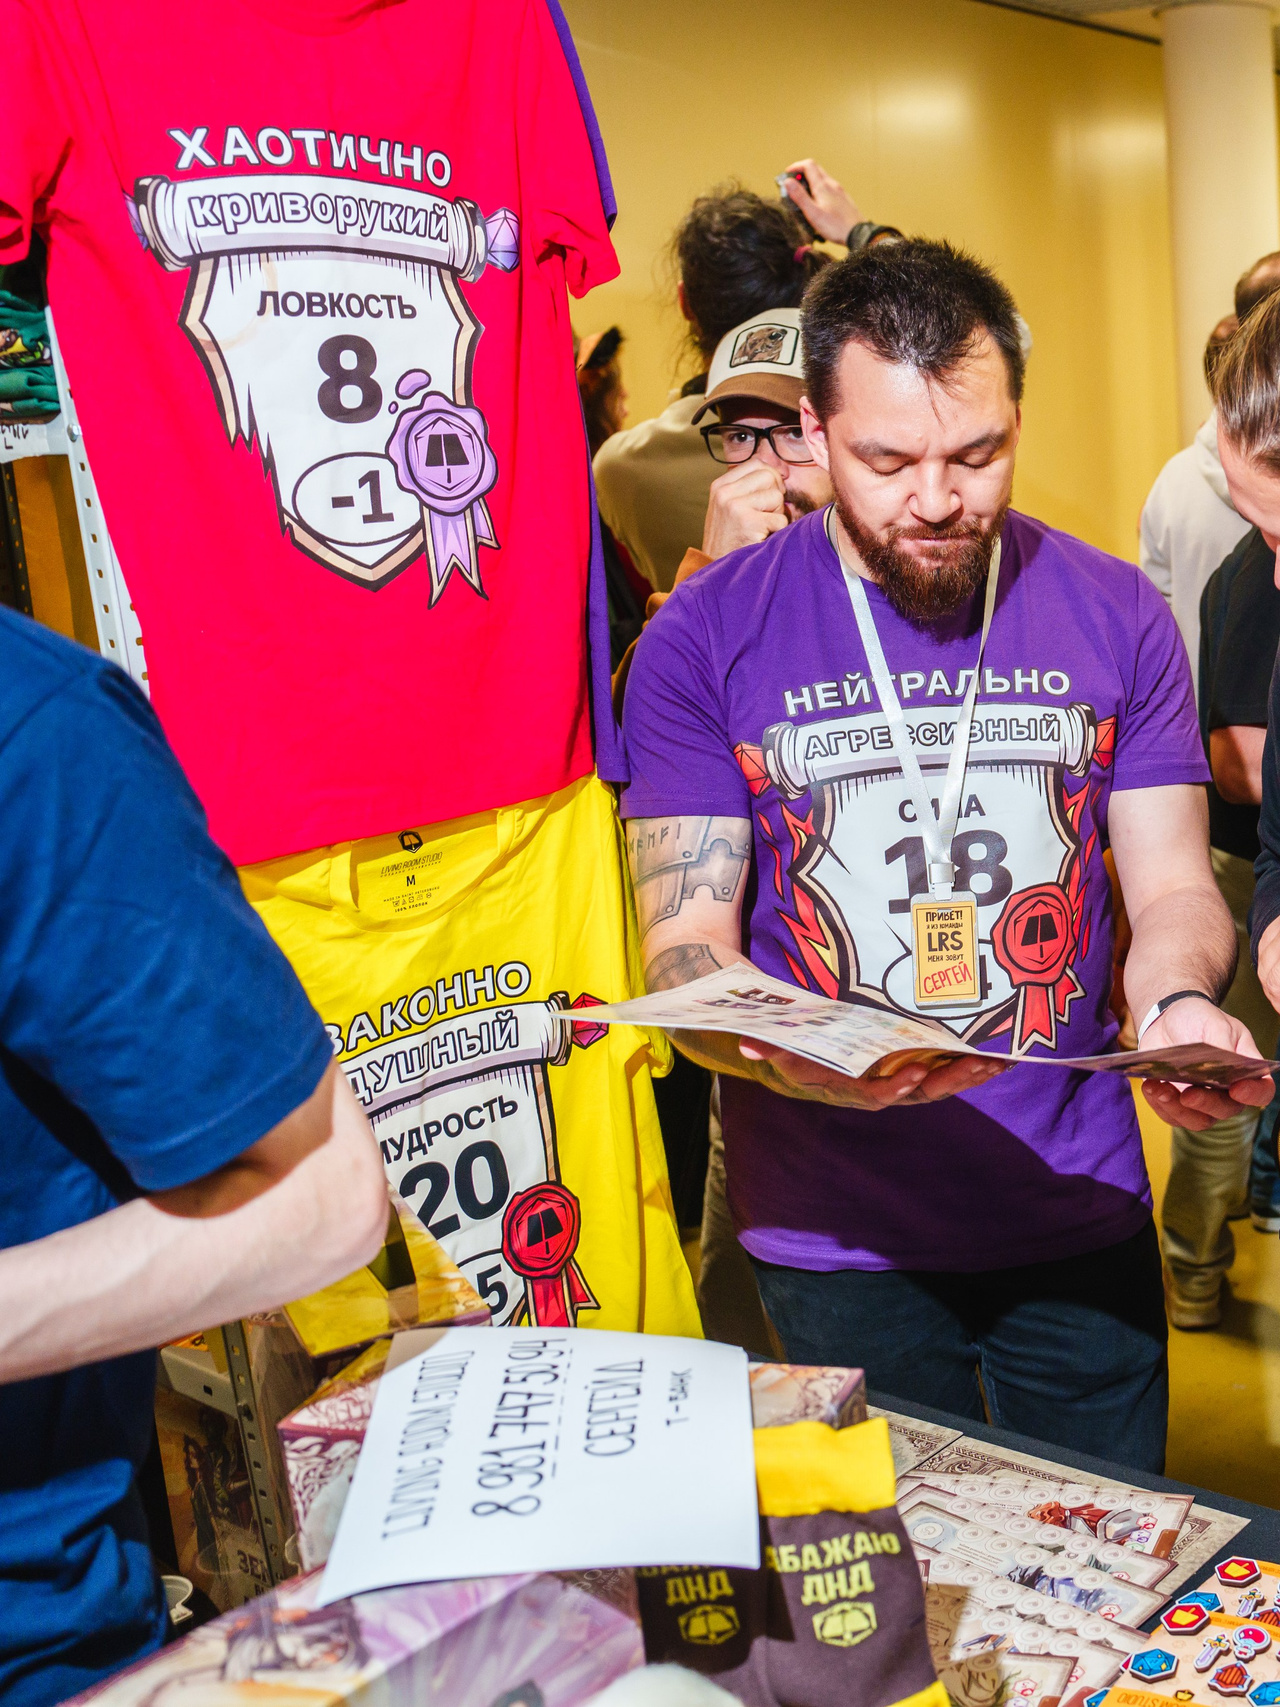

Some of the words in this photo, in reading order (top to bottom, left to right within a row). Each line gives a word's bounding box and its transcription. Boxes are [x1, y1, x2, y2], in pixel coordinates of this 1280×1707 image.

[168, 127, 451, 187] ХАОТИЧНО
[257, 290, 417, 319] ЛОВКОСТЬ
[317, 334, 382, 424] 8
[331, 470, 394, 524] -1
[783, 667, 1070, 716] НЕЙРАЛЬНО
[899, 794, 986, 822] СА
[422, 851, 443, 864] STUDIO
[885, 829, 1012, 914] 18
[406, 875, 416, 887] M
[925, 910, 963, 923] ПРИВЕТ!
[939, 922, 963, 930] КОМАНДЫ
[927, 931, 963, 952] LRS
[927, 955, 943, 963] МЕНЯ
[945, 953, 964, 962] ЗОВУТ
[923, 961, 972, 994] СЕРГЕЙ
[399, 1140, 510, 1240] 20
[488, 1391, 556, 1438] 747
[583, 1377, 643, 1457] СЕРГЕЙ
[476, 1440, 547, 1490] 981
[471, 1494, 541, 1516] 8
[667, 1569, 734, 1606] ДНД
[802, 1560, 876, 1606] ДНД
